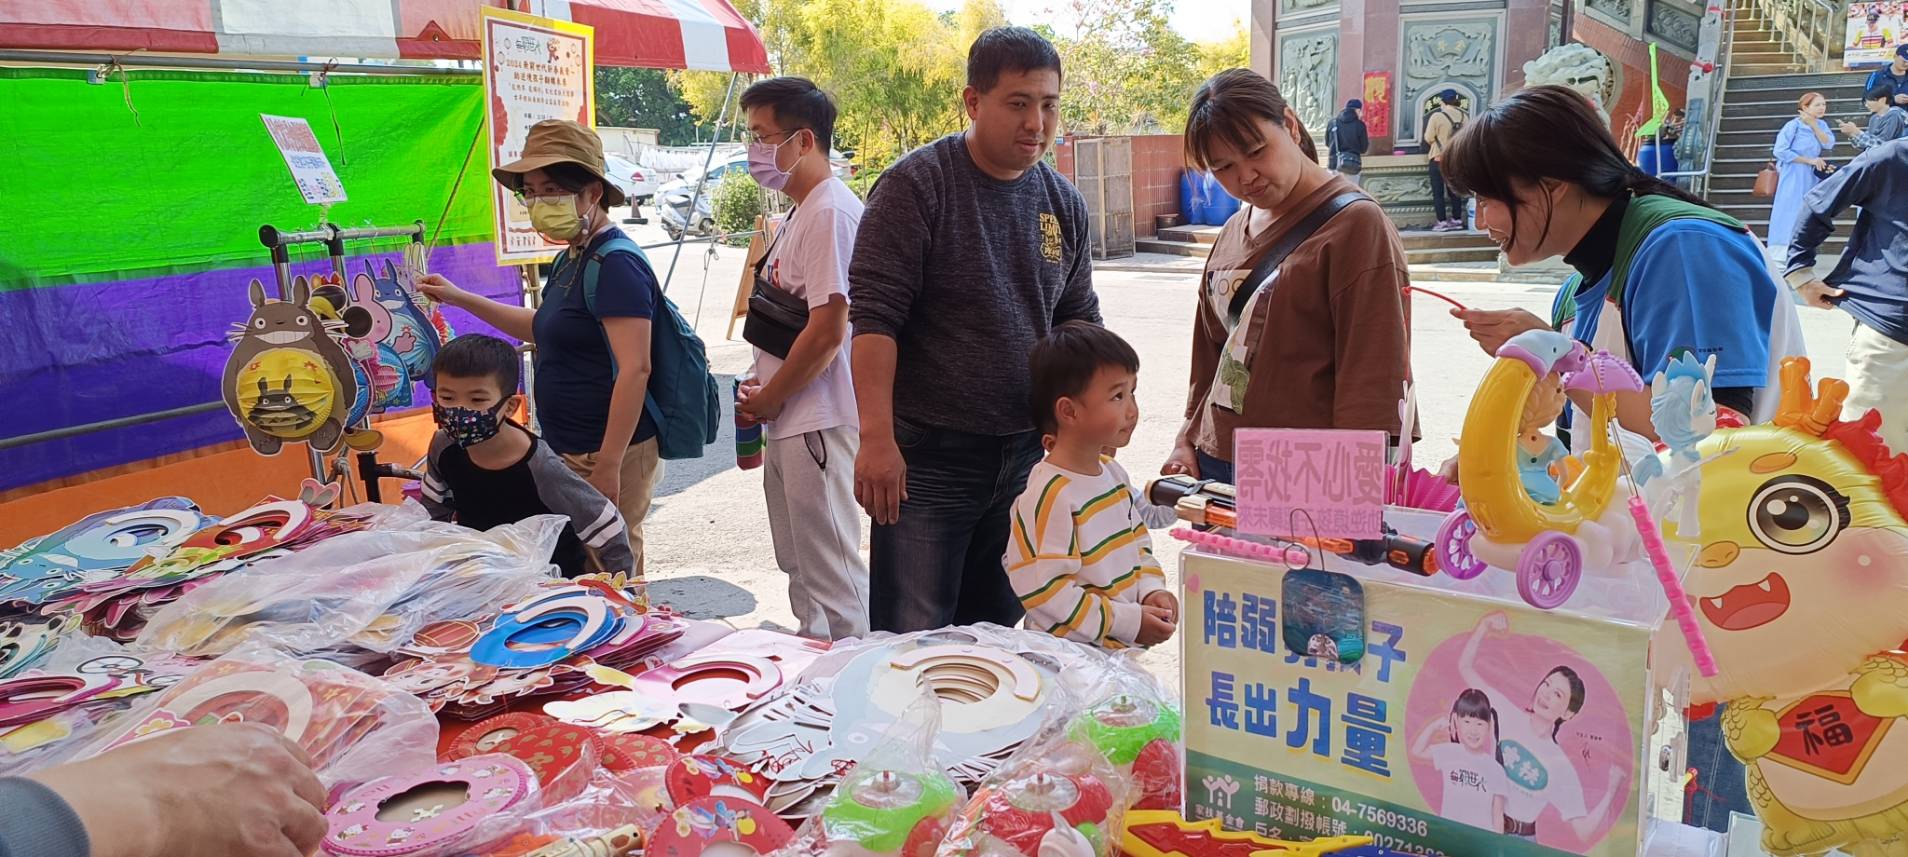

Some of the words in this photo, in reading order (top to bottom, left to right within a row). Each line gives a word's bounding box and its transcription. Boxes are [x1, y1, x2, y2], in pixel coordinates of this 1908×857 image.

[1204, 590, 1406, 683] 陪弱子
[1205, 671, 1392, 777] 長出力量
[1795, 704, 1853, 756] 福
